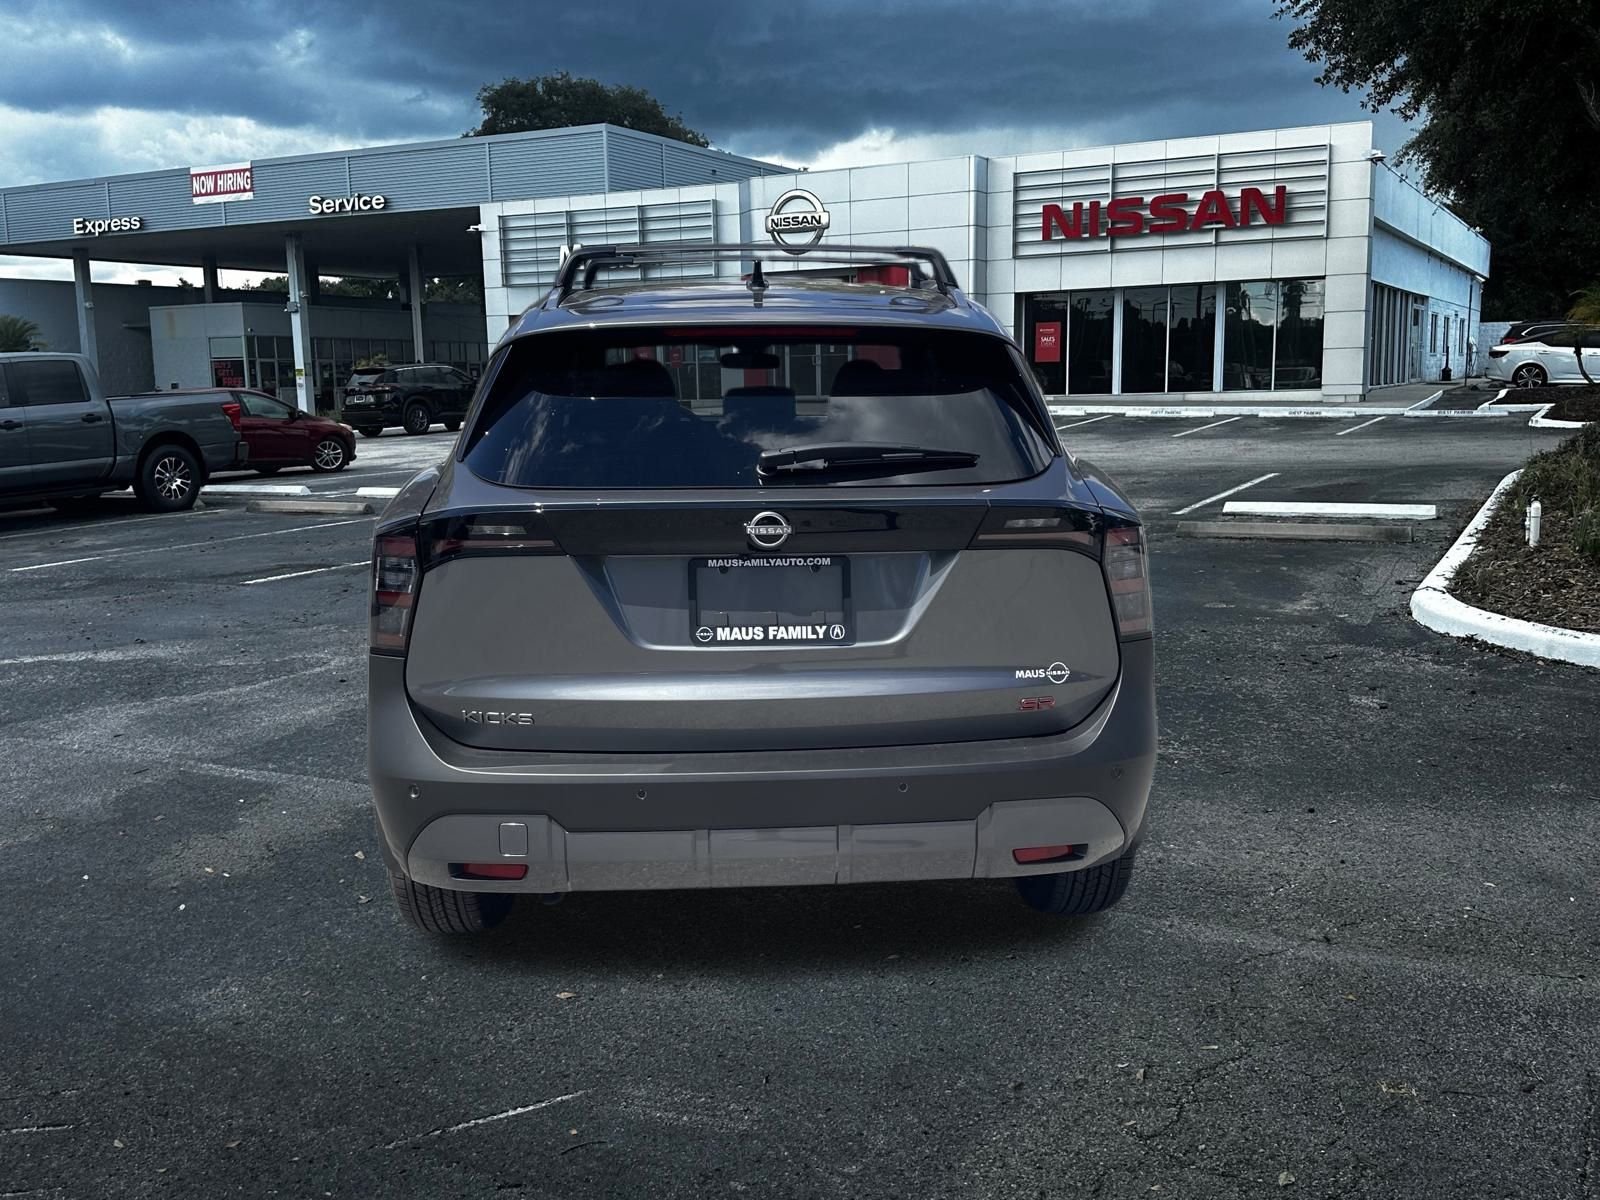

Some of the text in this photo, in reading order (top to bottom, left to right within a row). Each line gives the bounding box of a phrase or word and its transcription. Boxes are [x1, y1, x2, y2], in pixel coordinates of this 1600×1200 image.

[192, 170, 251, 195] NOW HIRING
[308, 192, 386, 215] Service
[770, 214, 822, 228] NISSAN
[1042, 185, 1287, 241] NISSAN
[72, 215, 142, 237] Express
[707, 557, 831, 567] MAUSFAMILYAUTO.COM
[716, 626, 764, 641] MAUS
[768, 625, 828, 640] FAMILY
[1015, 669, 1046, 679] MAUS
[1020, 696, 1056, 711] SR
[461, 709, 536, 725] KICKS
